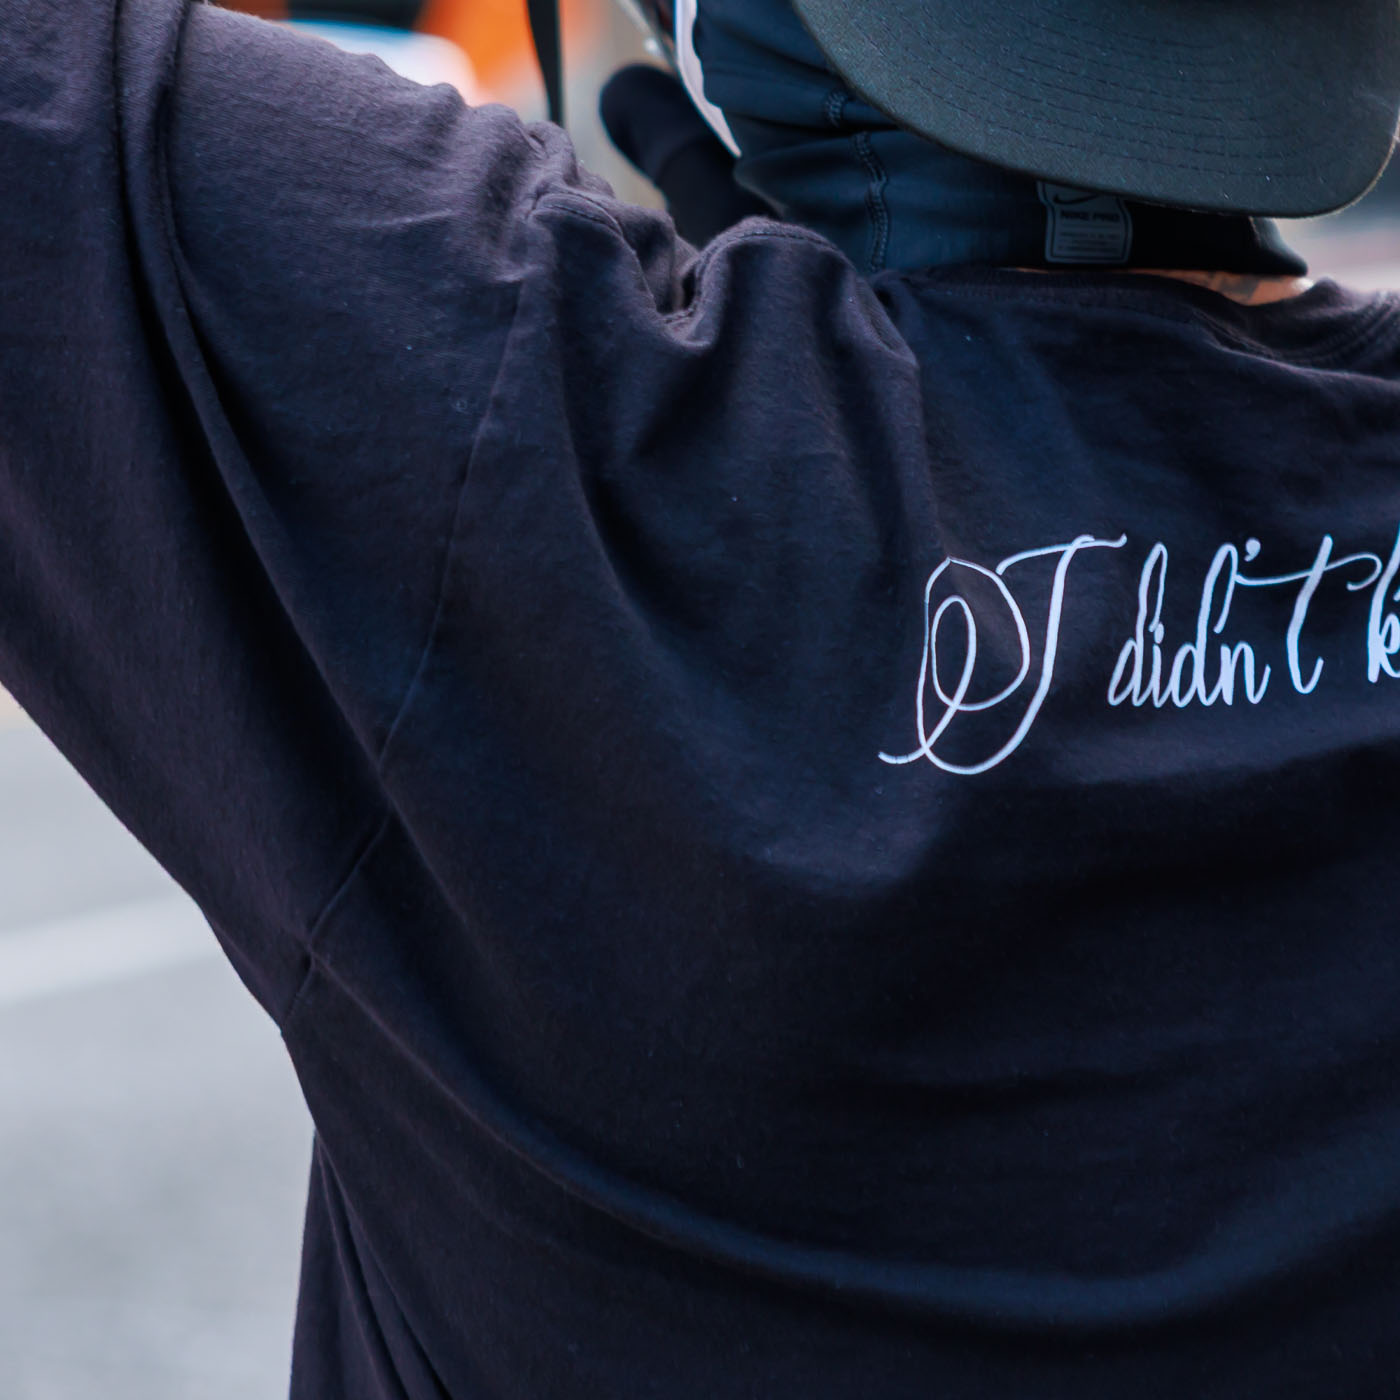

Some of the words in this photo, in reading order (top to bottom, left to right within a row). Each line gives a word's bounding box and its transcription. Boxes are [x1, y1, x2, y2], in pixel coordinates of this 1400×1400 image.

[1060, 208, 1090, 221] NIKE
[878, 535, 1127, 775] I
[1107, 536, 1382, 708] didn't
